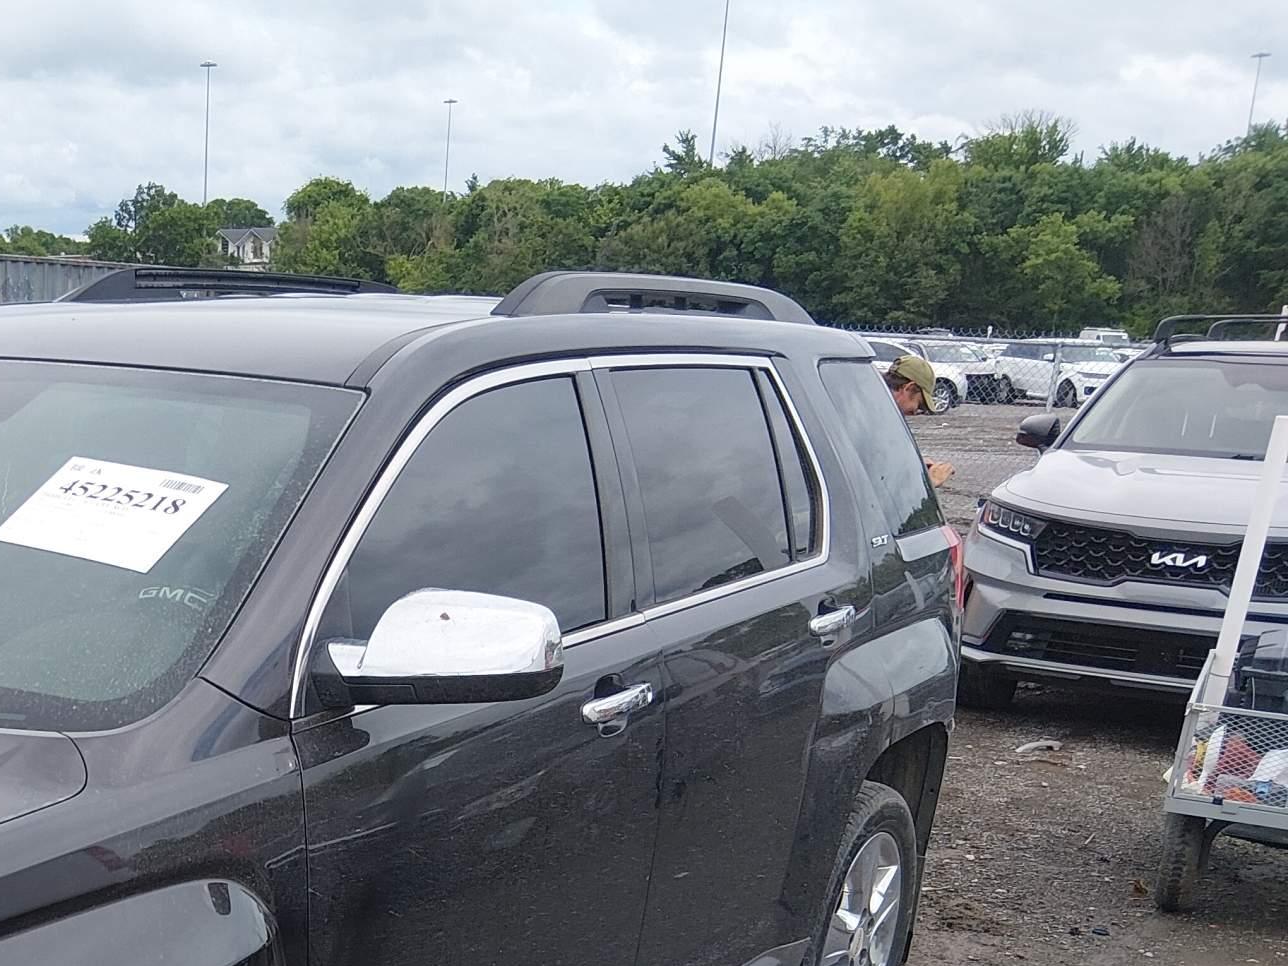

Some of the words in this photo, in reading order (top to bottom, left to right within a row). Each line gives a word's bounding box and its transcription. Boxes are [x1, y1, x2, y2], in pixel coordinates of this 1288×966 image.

[59, 480, 186, 514] 45225218
[1151, 551, 1207, 568] KIA
[139, 587, 214, 609] GMC
